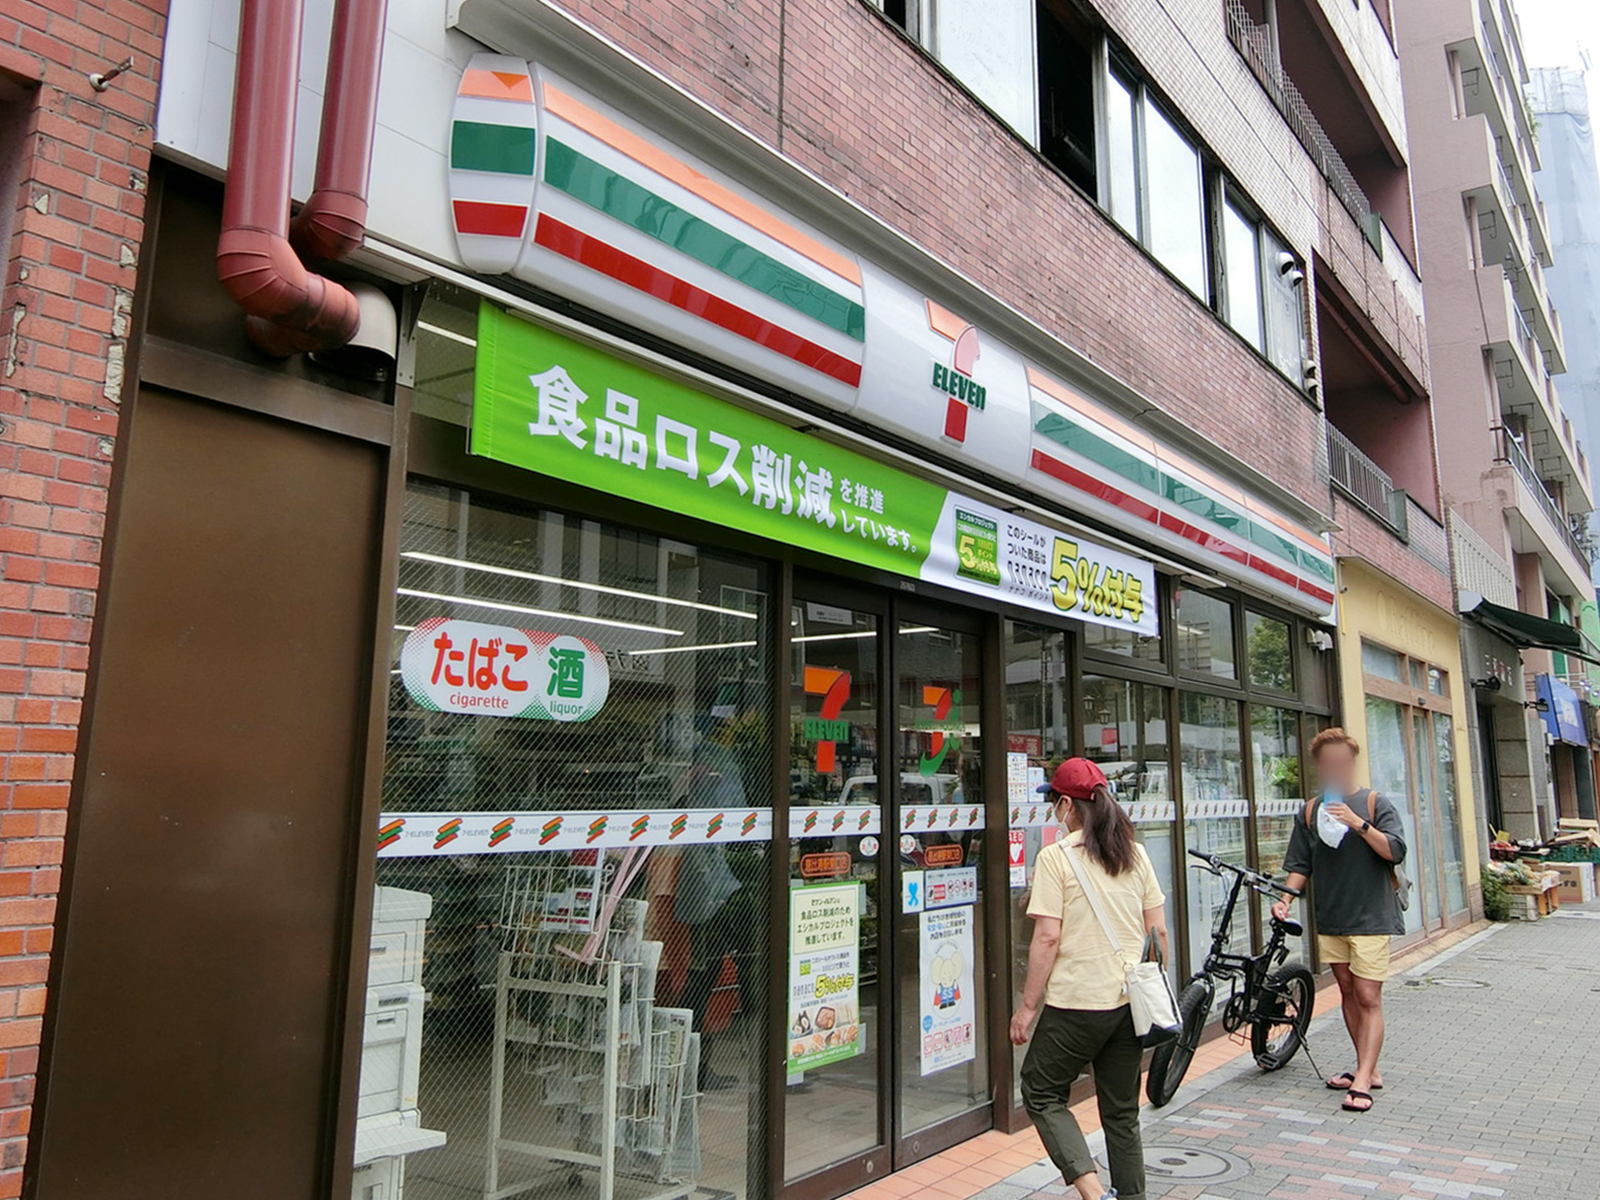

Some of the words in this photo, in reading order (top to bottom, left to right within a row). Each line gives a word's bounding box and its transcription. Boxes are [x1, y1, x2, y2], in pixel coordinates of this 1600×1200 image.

[528, 364, 837, 529] 食品ロス削減
[840, 478, 884, 514] を推進
[841, 509, 918, 553] しています。
[1007, 525, 1047, 548] このシールが
[1007, 543, 1047, 565] ついた商品は
[1007, 561, 1050, 593] nanaco
[1050, 537, 1144, 623] 5%付与
[431, 632, 528, 692] たばこ
[547, 646, 586, 699] 酒
[450, 691, 509, 709] cigarette
[550, 700, 584, 716] liquor
